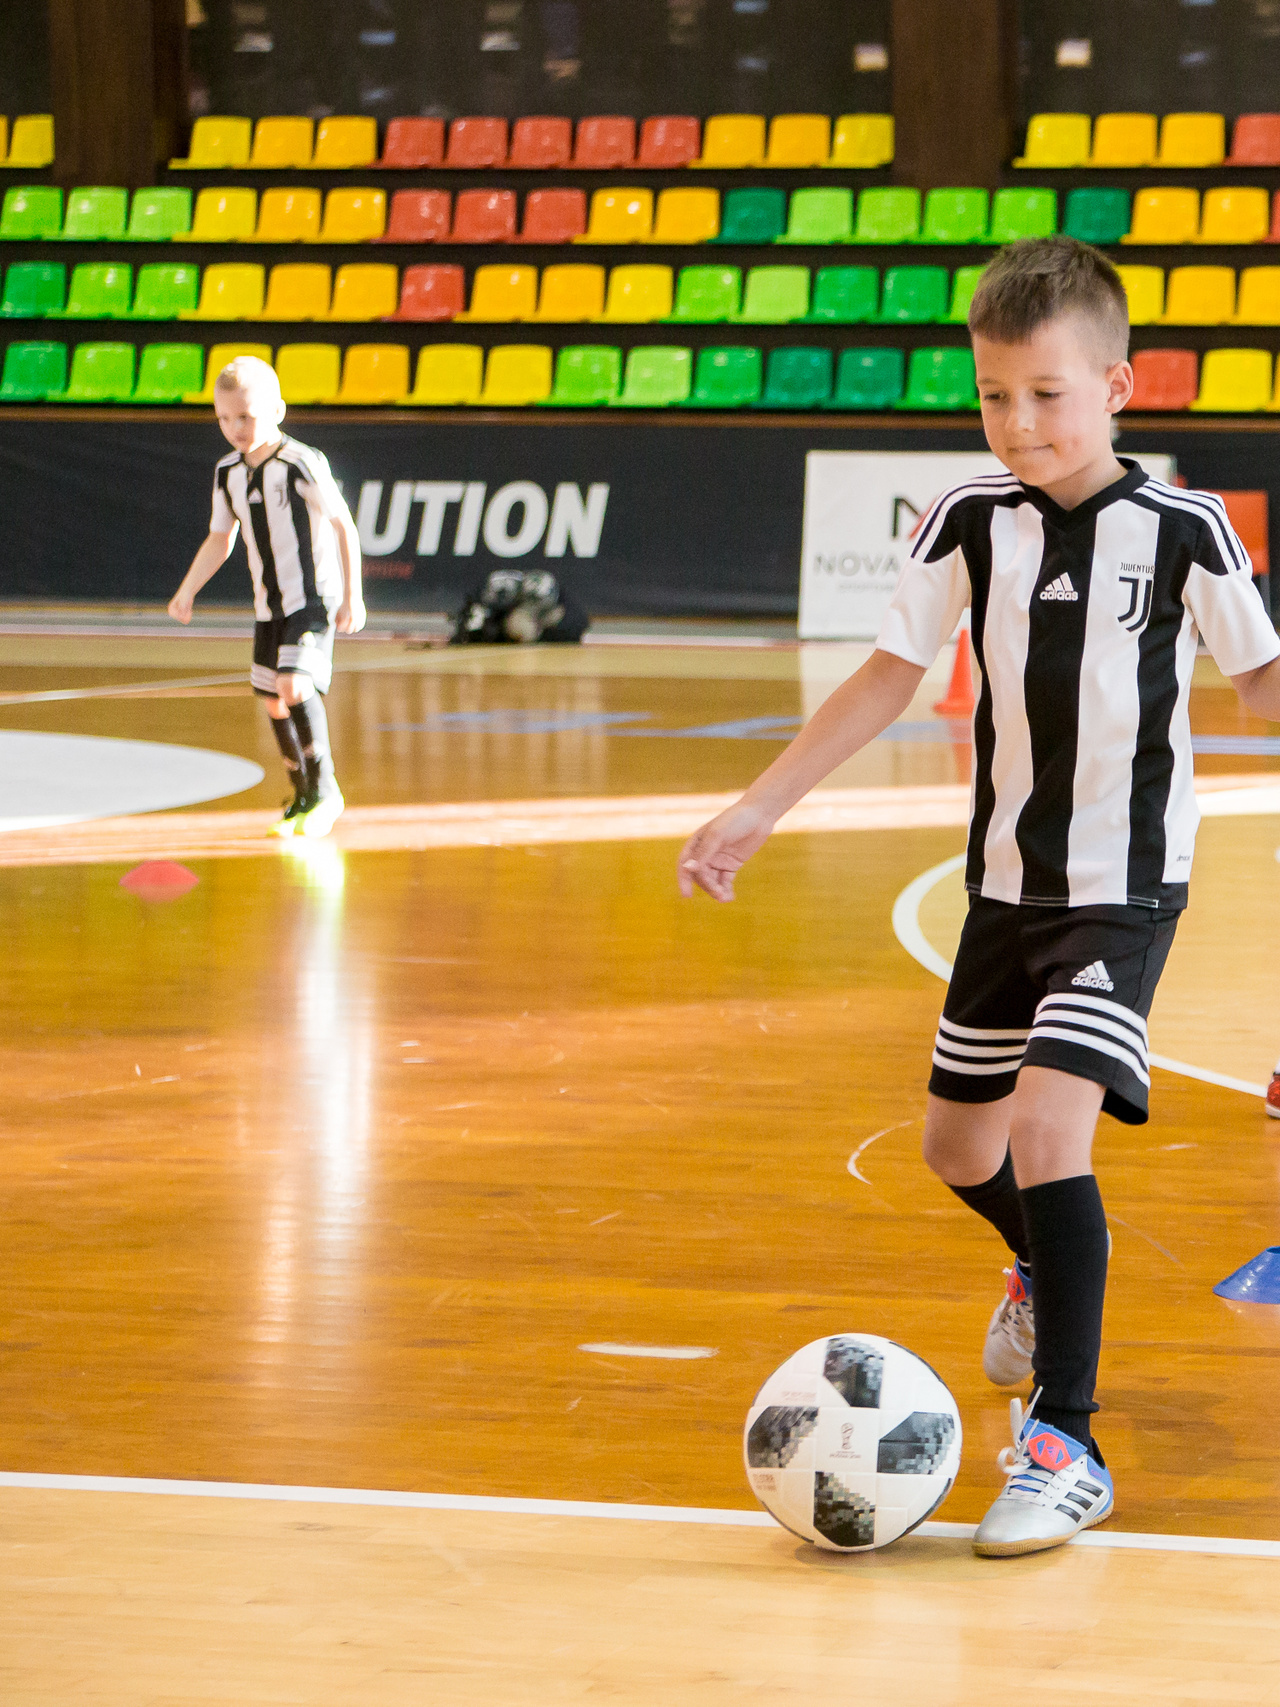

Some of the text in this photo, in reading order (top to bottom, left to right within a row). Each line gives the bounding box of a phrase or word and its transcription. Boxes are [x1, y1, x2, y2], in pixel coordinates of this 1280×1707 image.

[1120, 561, 1155, 574] JUVENTUS
[1039, 588, 1079, 601] adidas
[1071, 976, 1114, 992] adidas
